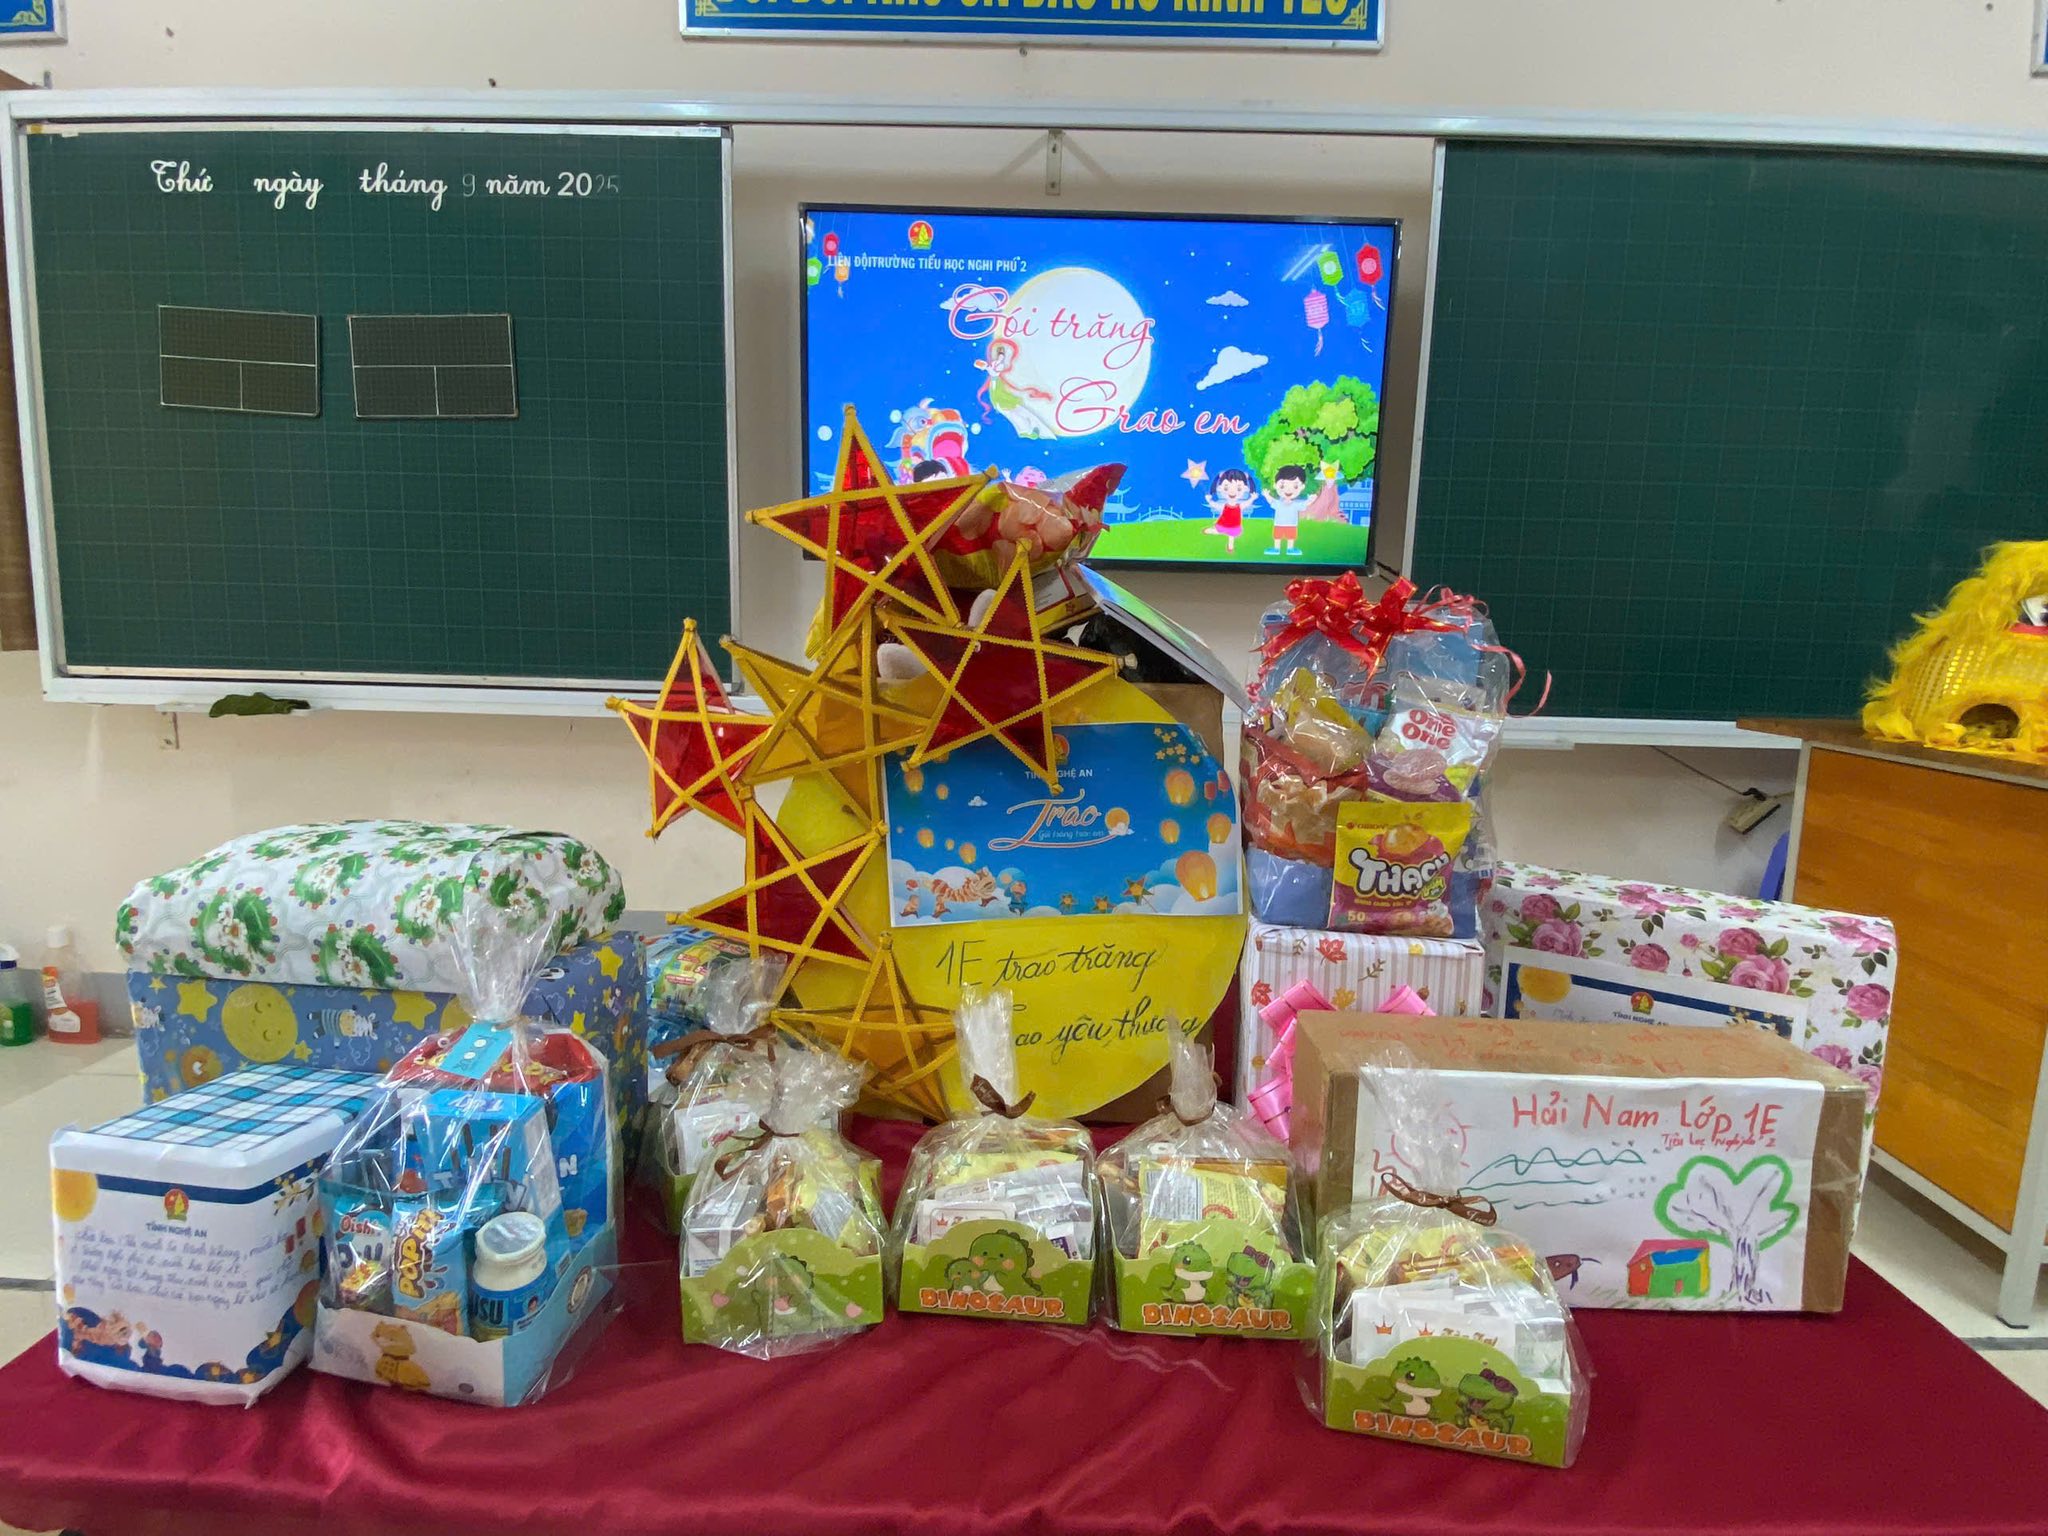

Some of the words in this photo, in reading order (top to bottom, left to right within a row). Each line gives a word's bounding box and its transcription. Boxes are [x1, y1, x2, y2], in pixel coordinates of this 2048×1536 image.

[151, 160, 214, 194] Thứ
[253, 171, 324, 210] ngày
[358, 163, 448, 212] tháng
[462, 173, 476, 197] 9
[485, 176, 551, 197] năm
[828, 252, 851, 268] LIÊN
[919, 253, 941, 270] TIỂU
[944, 257, 965, 273] HỌC
[967, 258, 993, 272] NGHI
[996, 256, 1018, 273] PHÚ
[1020, 260, 1027, 273] 2
[1050, 307, 1156, 370] trăng
[1193, 410, 1250, 435] em
[1402, 722, 1451, 750] One
[1409, 709, 1456, 738] One
[1079, 768, 1093, 778] AN
[1000, 788, 1106, 848] Trao
[936, 940, 985, 986] 1E
[993, 948, 1056, 987] trao
[1058, 943, 1158, 992] trăng
[1047, 1014, 1112, 1065] yêu
[1512, 1091, 1568, 1128] Hải
[1583, 1093, 1660, 1128] Nam
[1680, 1095, 1732, 1140] Lớp
[1744, 1103, 1784, 1135] 1E
[194, 1229, 207, 1238] AN
[919, 1288, 1065, 1318] DINOSAUR
[1142, 1303, 1292, 1331] DINOSAUR
[1353, 1409, 1533, 1458] DINOSAUR
